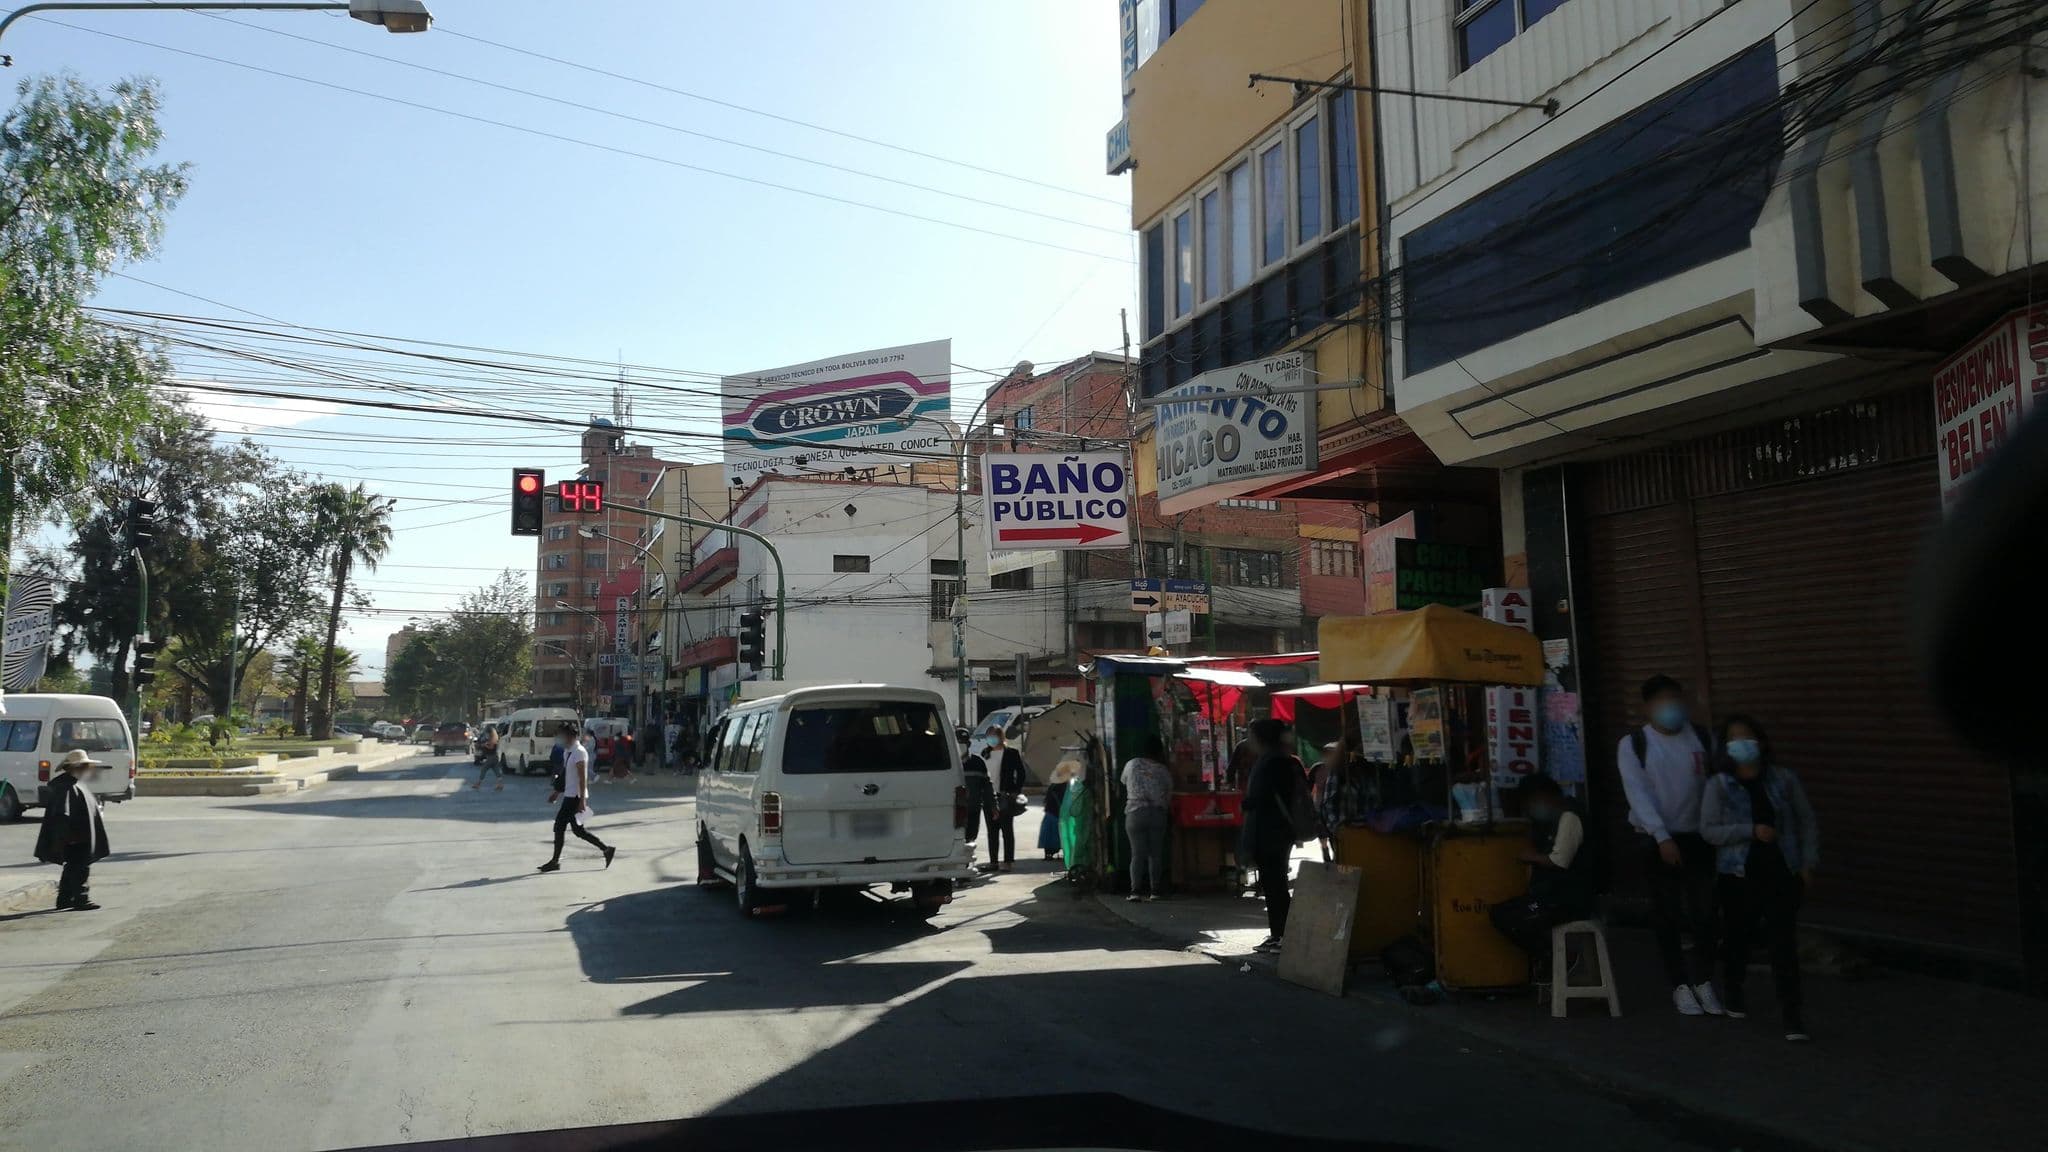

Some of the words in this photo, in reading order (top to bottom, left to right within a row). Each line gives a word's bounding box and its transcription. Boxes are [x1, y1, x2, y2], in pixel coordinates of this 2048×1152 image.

[764, 374, 790, 383] SERVICIO
[791, 369, 815, 380] TECNICO
[816, 366, 824, 374] EN
[825, 364, 841, 373] TODA
[841, 360, 867, 370] BOLIVIA
[1264, 363, 1274, 375] TV
[1275, 356, 1301, 372] CABLE
[1283, 369, 1301, 383] WIFI
[1236, 372, 1250, 392] CON
[1936, 332, 2014, 427] RESIDENCIAL
[779, 395, 883, 429] CROWN
[844, 425, 880, 439] JAPAN
[1947, 400, 2007, 481] BELEN
[732, 455, 785, 473] TECNOLOGIA
[790, 450, 834, 466] JAONESA
[900, 436, 939, 450] CONOCE
[1254, 448, 1278, 461] DOBLES
[1278, 443, 1303, 457] TRIPLES
[990, 456, 1124, 495] BAÑO
[1217, 463, 1256, 478] MATRIMONIAL
[1277, 455, 1303, 468] PRIVADO
[561, 482, 600, 511] 44
[993, 496, 1127, 521] PÚBLICO
[1175, 593, 1209, 604] AYACUCHO
[617, 598, 628, 653] ALOJAMIENTO
[1501, 592, 1534, 774] ALIENTO
